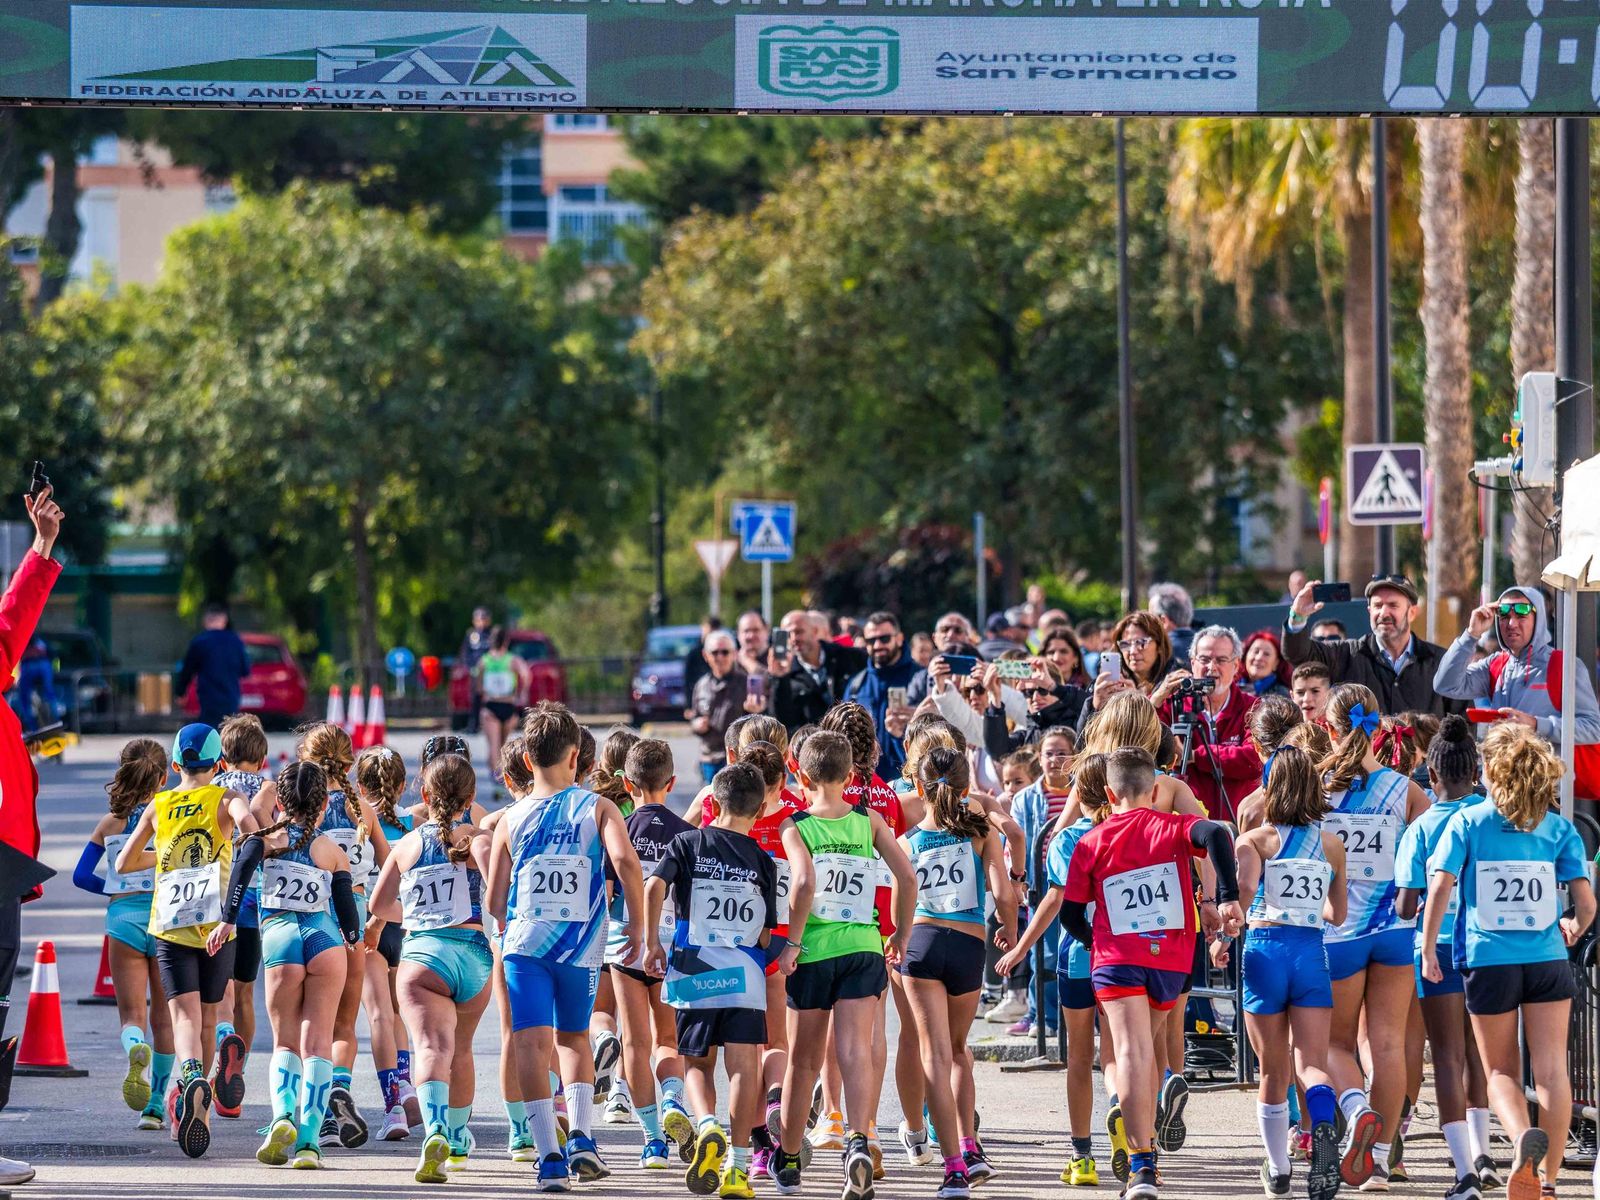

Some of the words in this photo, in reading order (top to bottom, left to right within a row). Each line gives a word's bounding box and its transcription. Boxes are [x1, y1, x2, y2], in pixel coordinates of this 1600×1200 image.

[779, 46, 880, 61] SAN
[936, 51, 1184, 65] Ayuntamiento
[1193, 52, 1237, 64] de
[936, 66, 1016, 79] San
[1028, 66, 1238, 80] Fernando
[81, 84, 235, 98] FEDERACIÓN
[247, 88, 386, 100] ANDALUZA
[398, 90, 428, 101] DE
[440, 91, 577, 102] ATLETISMO
[1336, 830, 1383, 854] 224
[532, 871, 578, 895] 203
[824, 869, 864, 896] 205
[916, 860, 964, 891] 226
[1280, 874, 1323, 901] 233
[169, 878, 210, 905] 207
[231, 883, 243, 907] KIPSTA
[275, 876, 320, 904] 228
[412, 877, 455, 907] 217
[1121, 880, 1169, 911] 204
[1493, 877, 1542, 902] 220
[706, 896, 754, 923] 206
[697, 977, 739, 991] JUCAMP
